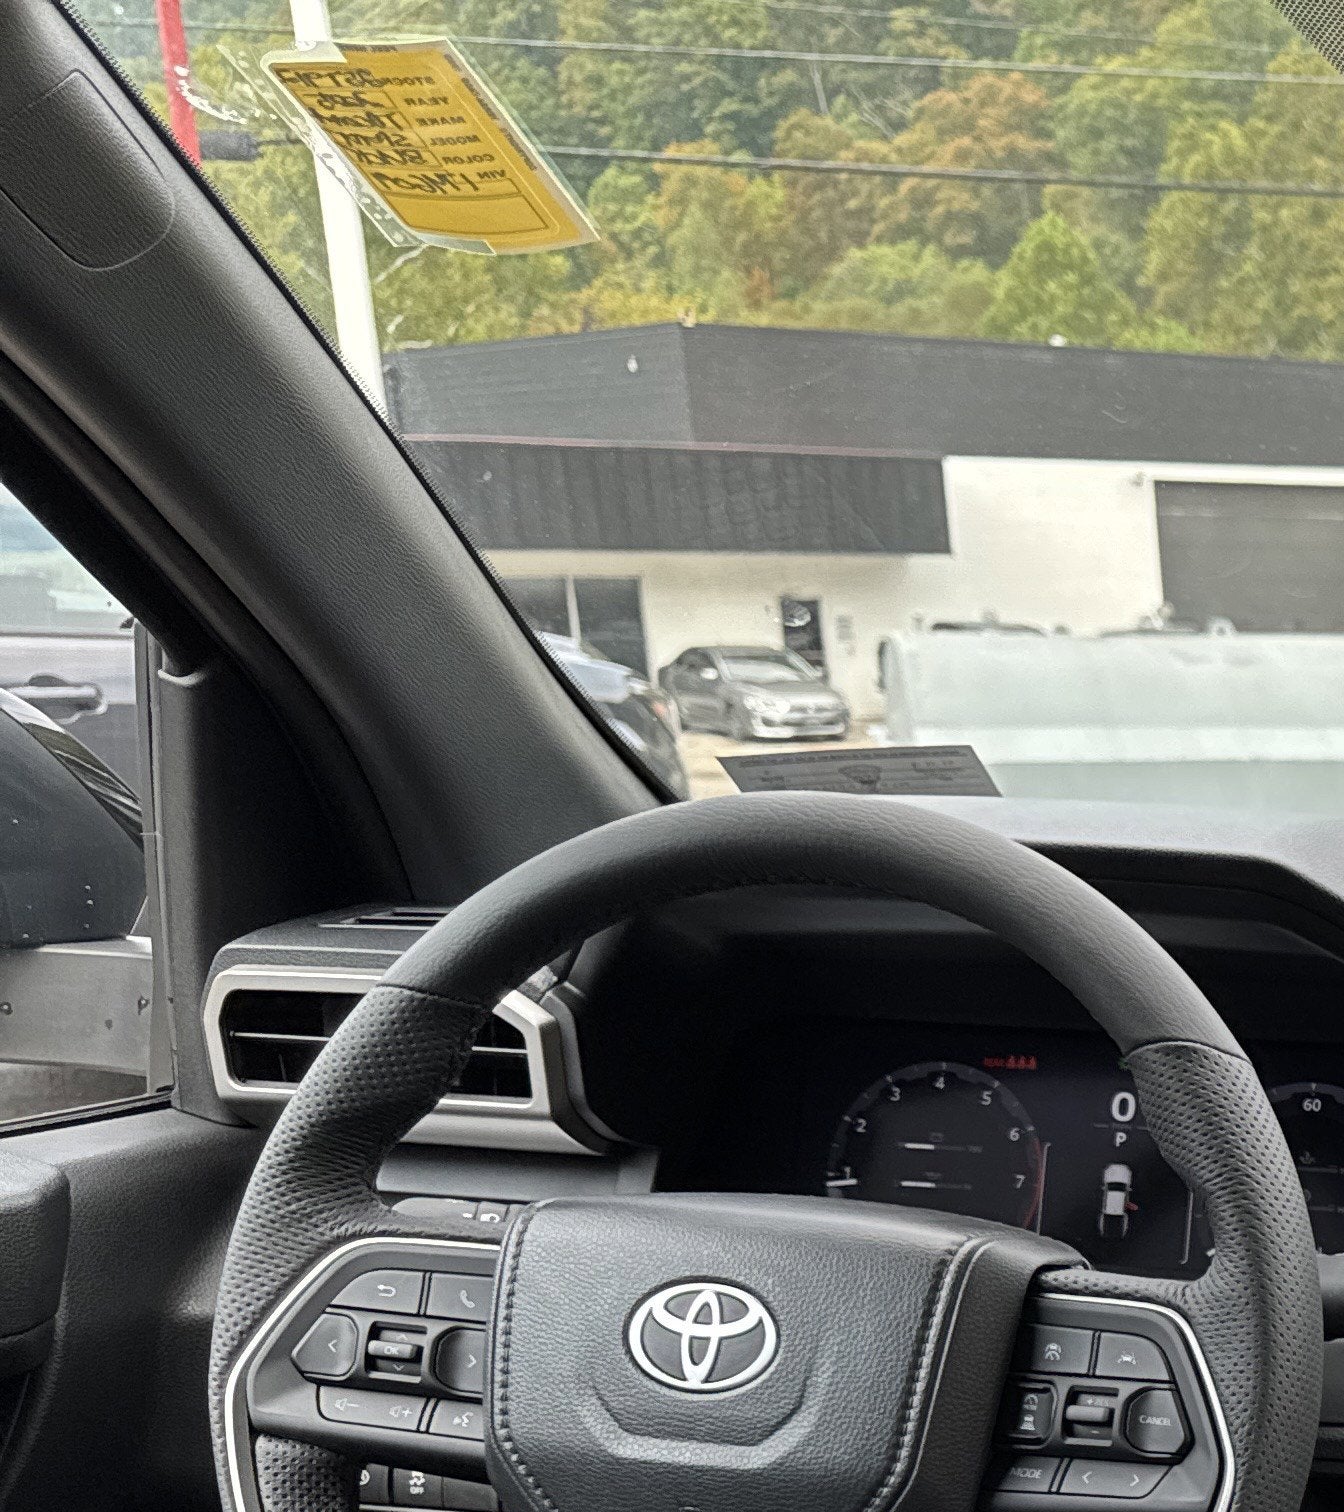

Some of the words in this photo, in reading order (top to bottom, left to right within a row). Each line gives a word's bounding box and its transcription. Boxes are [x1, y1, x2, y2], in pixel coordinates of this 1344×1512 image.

[933, 1076, 946, 1090] 4
[890, 1086, 901, 1101] 3
[981, 1090, 993, 1105] 5
[1111, 1091, 1136, 1122] 0
[1302, 1099, 1322, 1112] 60
[855, 1118, 867, 1133] 2
[1009, 1127, 1020, 1141] 6
[1115, 1131, 1127, 1147] P
[1015, 1174, 1026, 1189] 7
[1139, 1415, 1171, 1427] CANCEL
[1010, 1466, 1042, 1479] MODE
